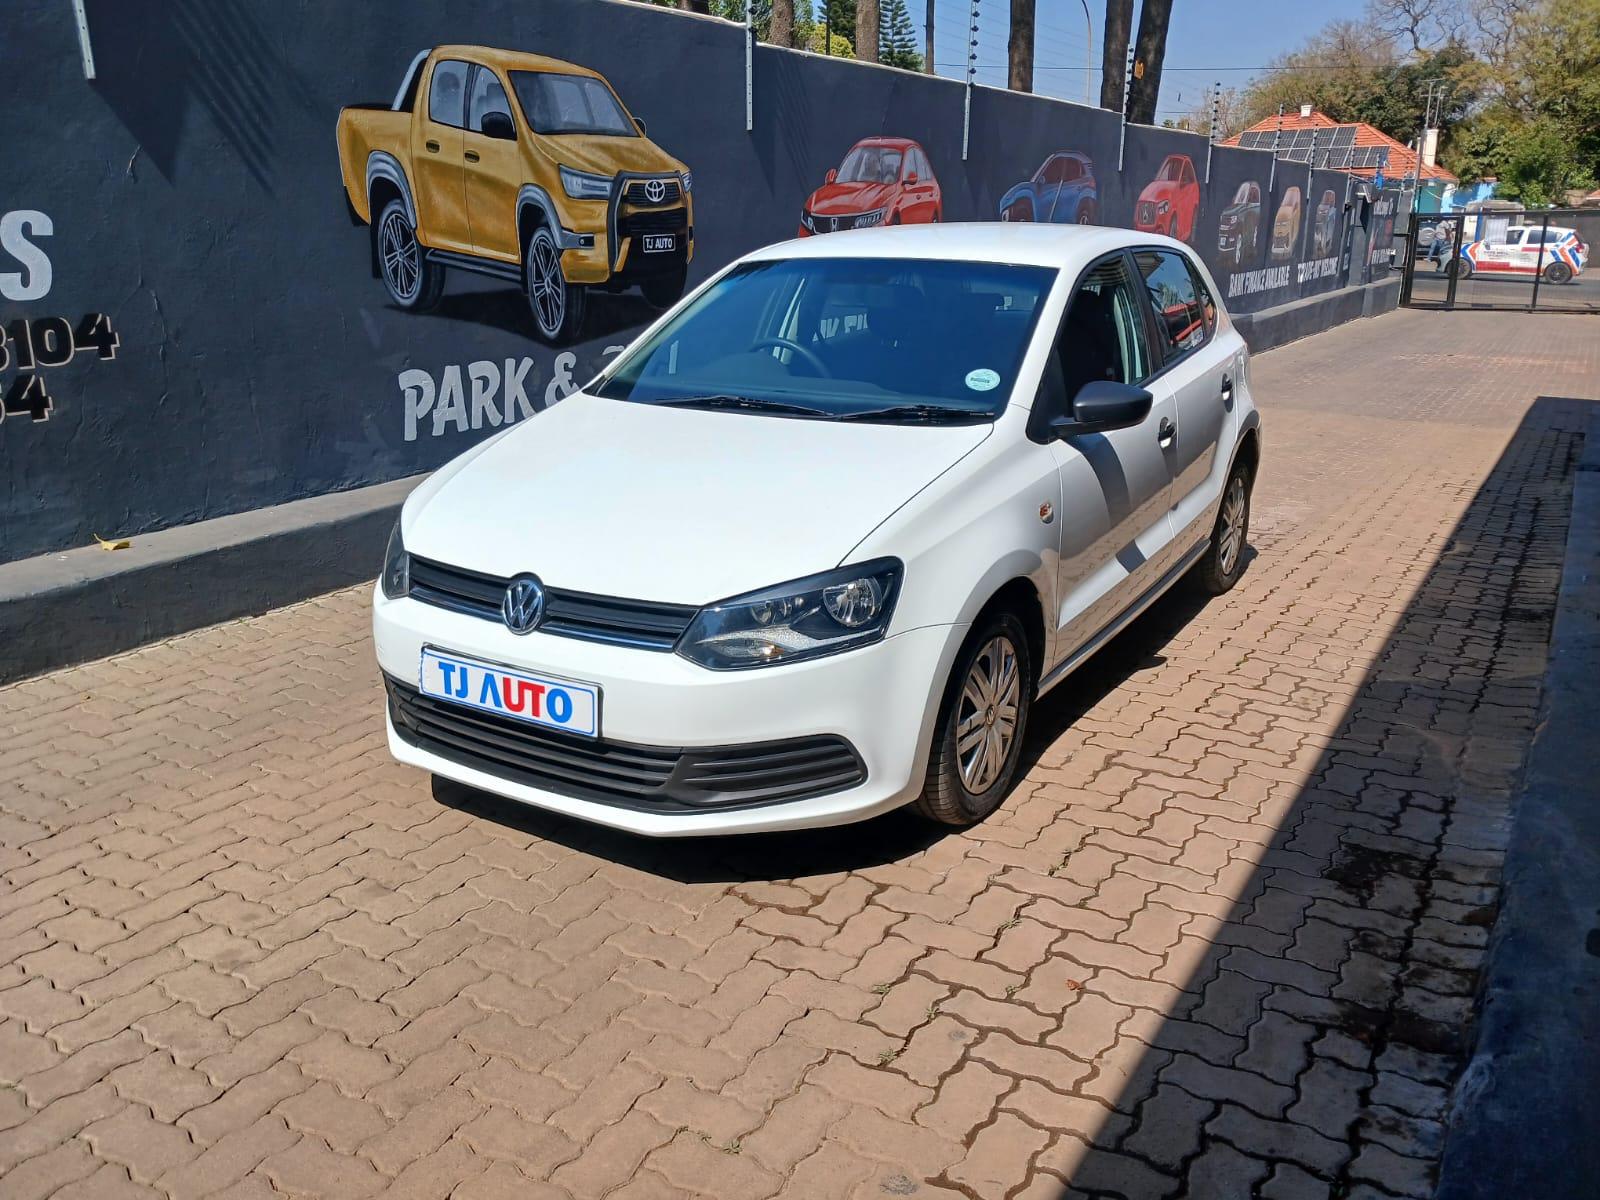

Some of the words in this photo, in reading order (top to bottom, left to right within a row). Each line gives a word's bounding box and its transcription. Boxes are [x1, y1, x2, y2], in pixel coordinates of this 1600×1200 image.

[645, 238, 653, 249] TJ
[655, 237, 673, 249] AUTO
[1228, 272, 1245, 298] BANK
[398, 356, 537, 442] PARK
[438, 660, 468, 699] TJ
[479, 672, 573, 724] AUTO
